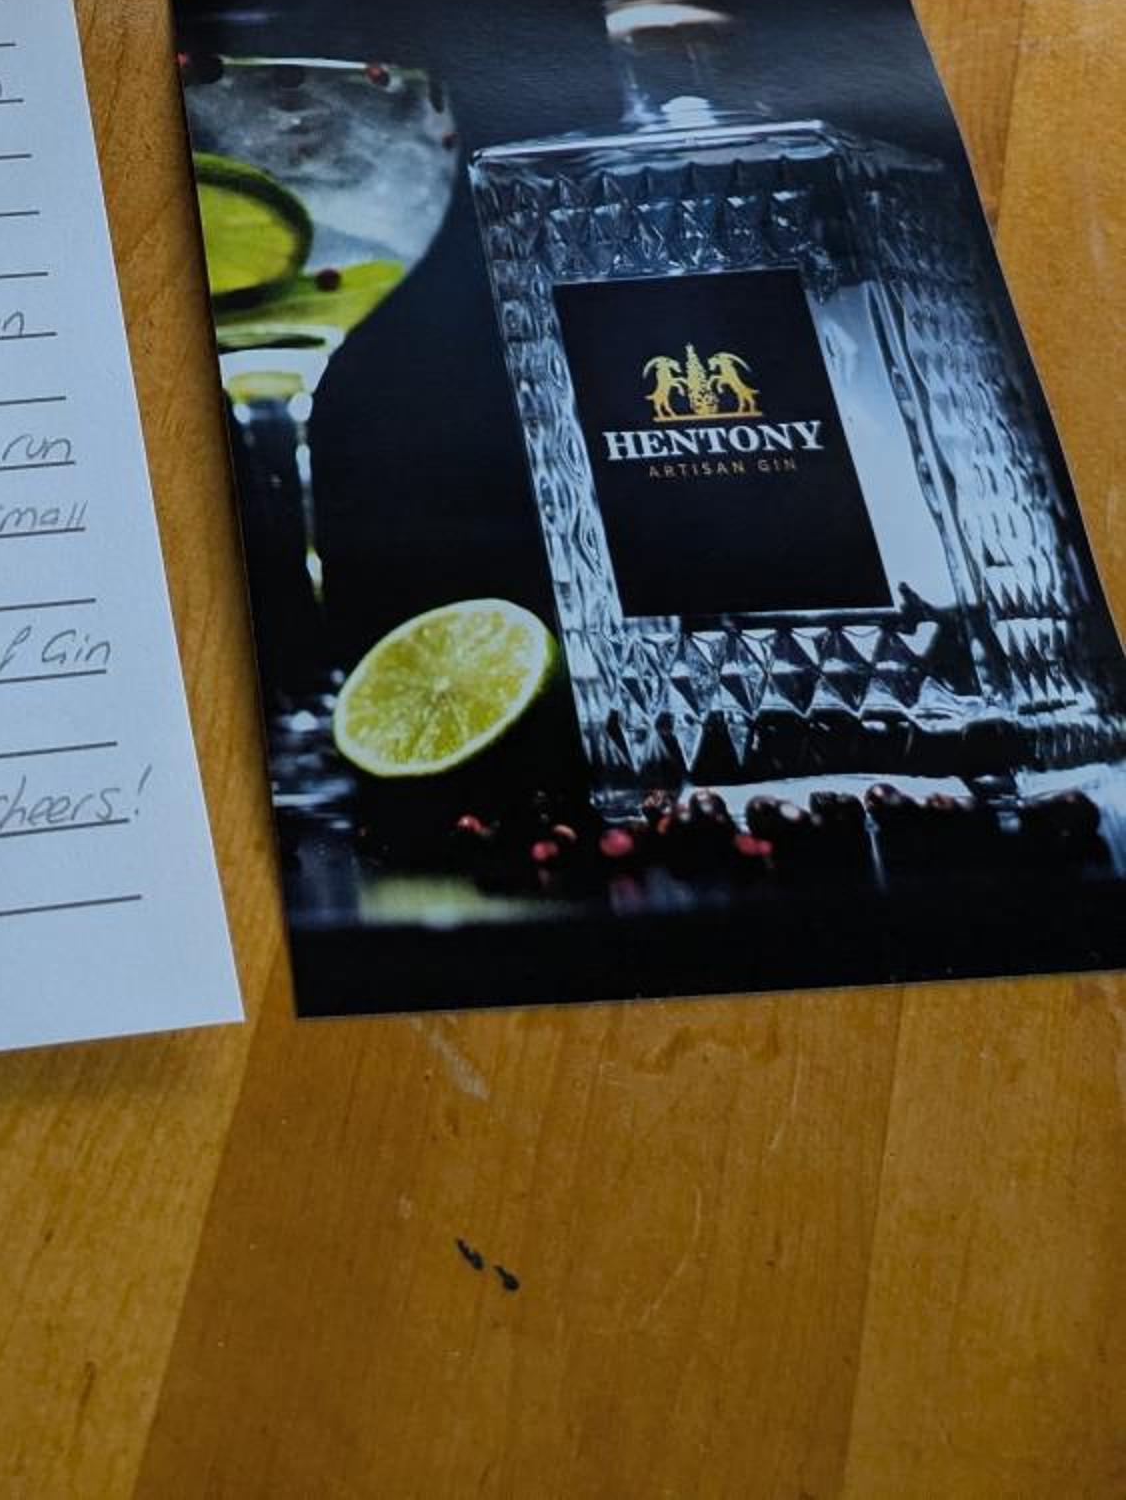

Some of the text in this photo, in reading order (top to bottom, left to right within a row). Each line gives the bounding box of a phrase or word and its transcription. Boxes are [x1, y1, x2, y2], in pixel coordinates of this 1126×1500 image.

[1, 434, 72, 462] run
[602, 421, 824, 461] HENTONY
[649, 459, 796, 478] ARTISAN GIN
[40, 629, 111, 665] Gin
